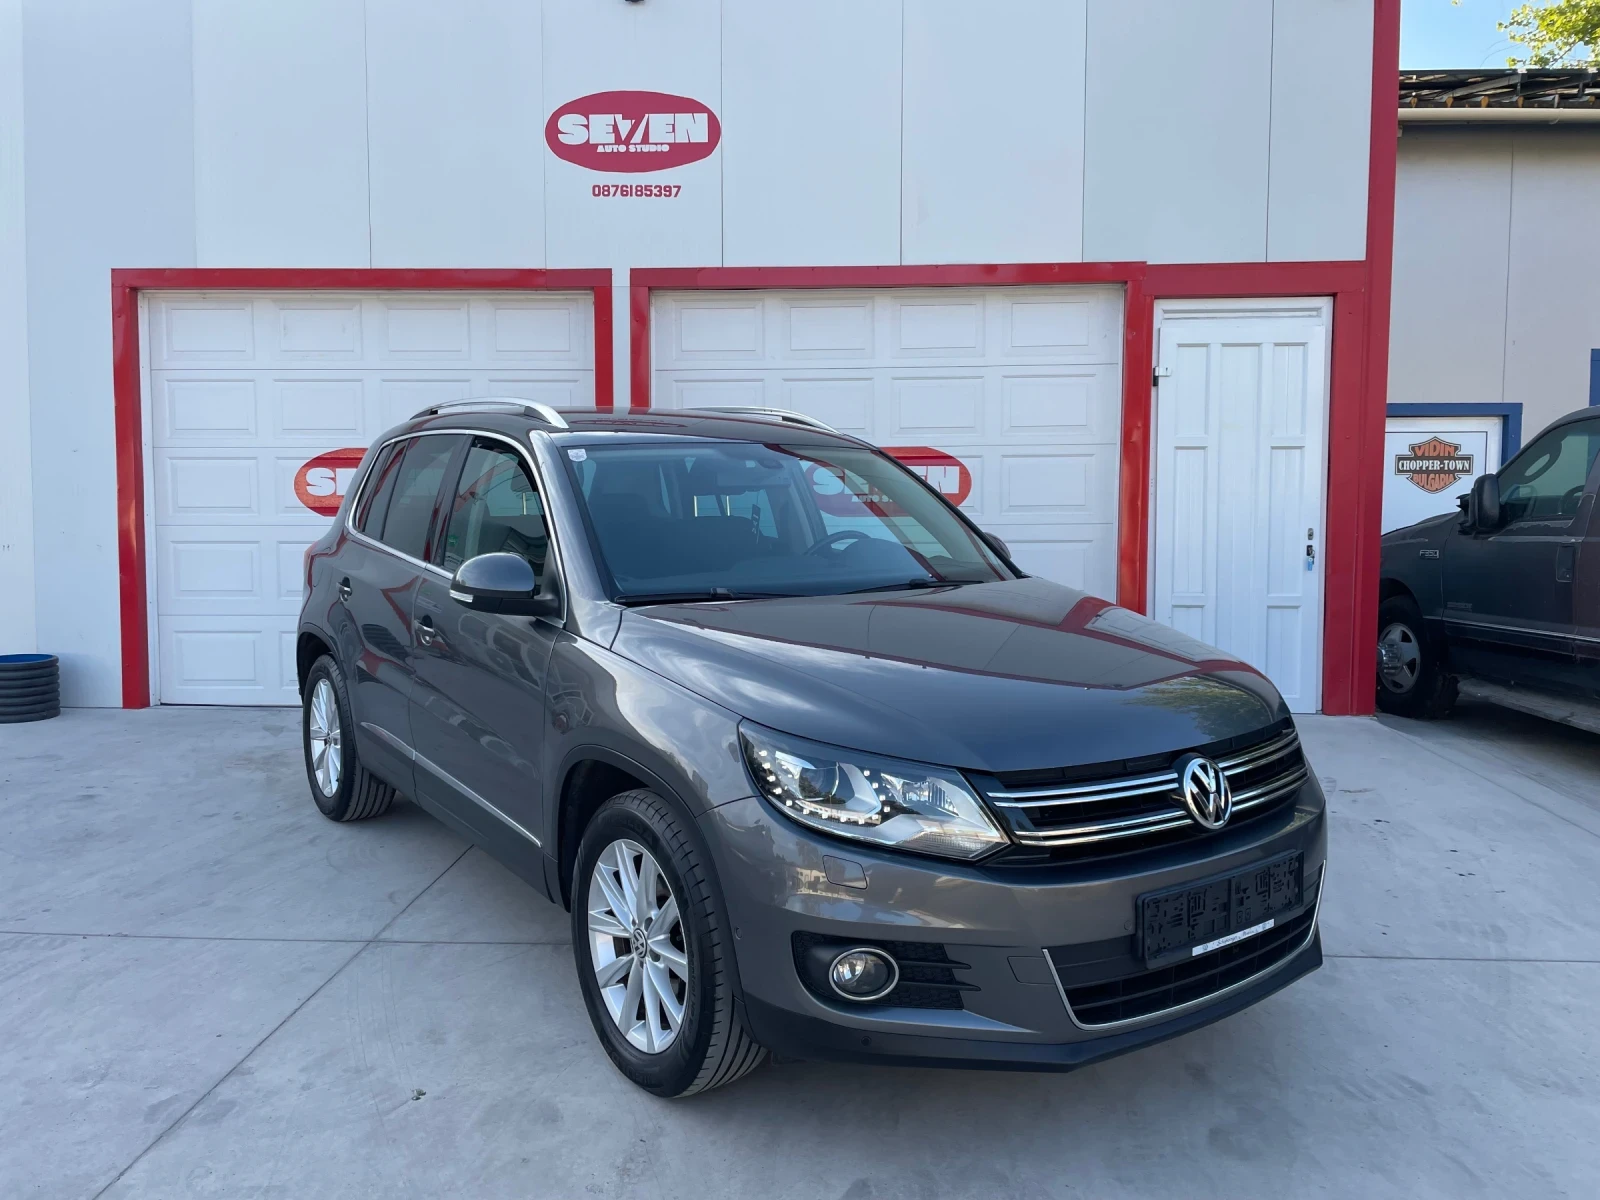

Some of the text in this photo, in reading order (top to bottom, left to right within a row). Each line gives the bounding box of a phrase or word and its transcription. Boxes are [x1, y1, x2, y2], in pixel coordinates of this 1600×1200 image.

[557, 113, 708, 145] SEVEN
[597, 145, 627, 153] AUTO
[592, 185, 681, 198] 0876185397
[1414, 440, 1455, 457] VIDIN
[1398, 460, 1470, 471] CHOPPER-TOWN
[813, 465, 960, 495] SEN
